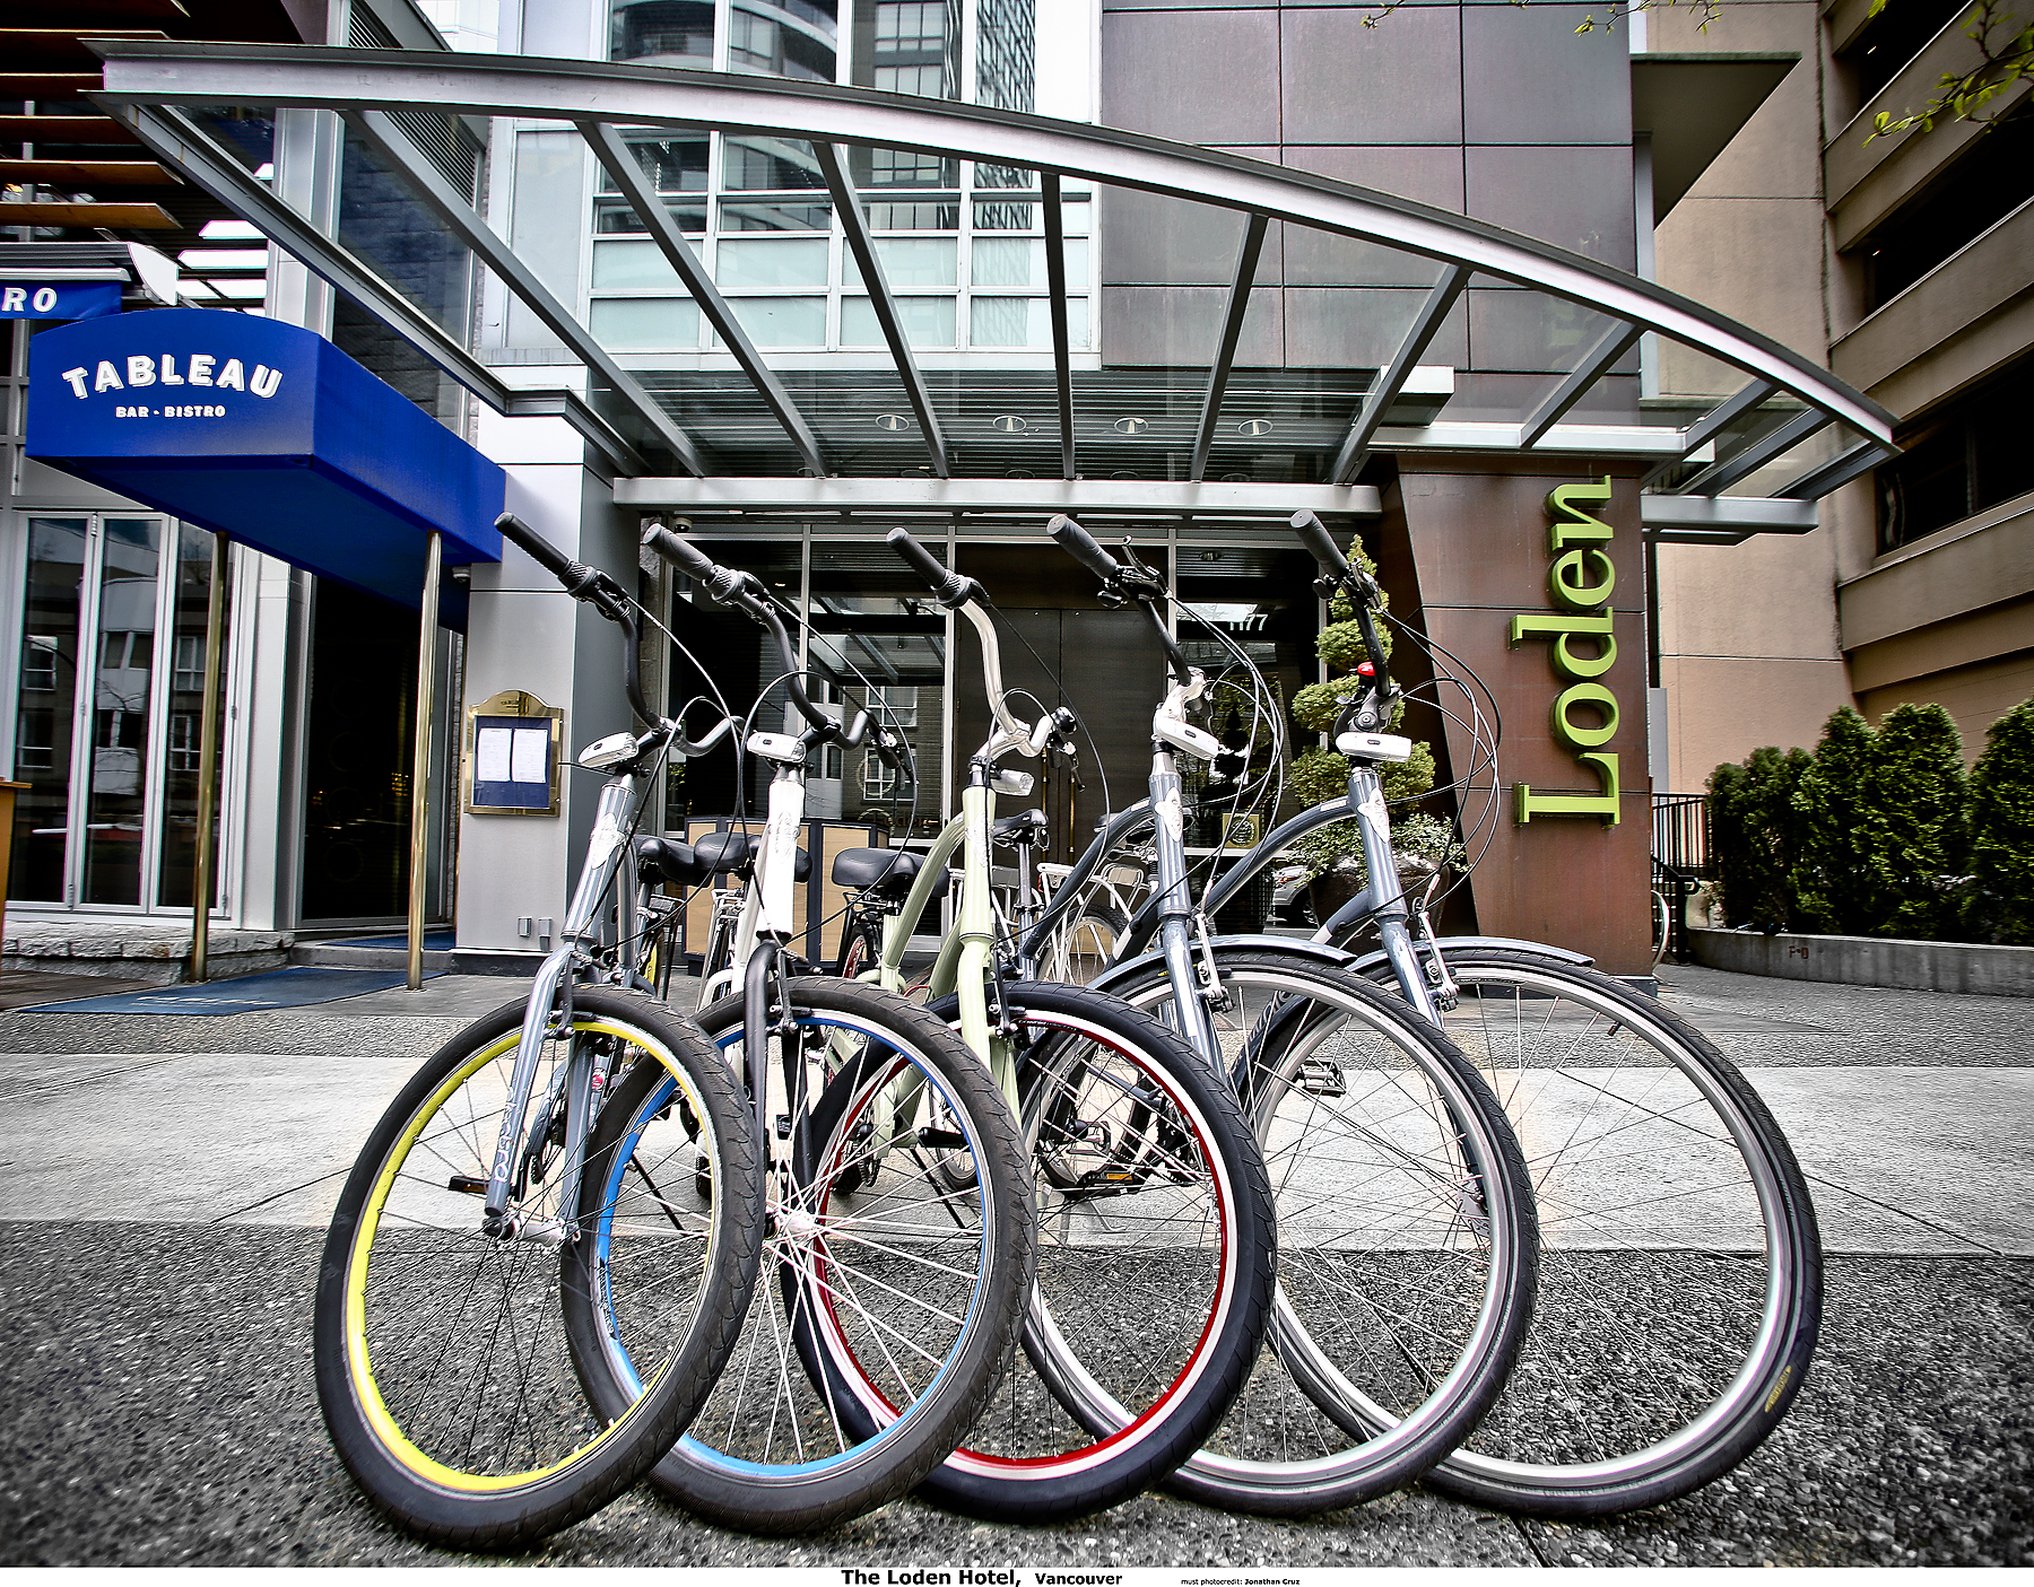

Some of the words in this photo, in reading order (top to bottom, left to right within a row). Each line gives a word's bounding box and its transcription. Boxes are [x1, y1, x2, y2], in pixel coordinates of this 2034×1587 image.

[62, 353, 283, 400] TABLEAU
[115, 405, 150, 418] BAR
[164, 405, 226, 418] BISTRO
[1509, 474, 1621, 827] Loden
